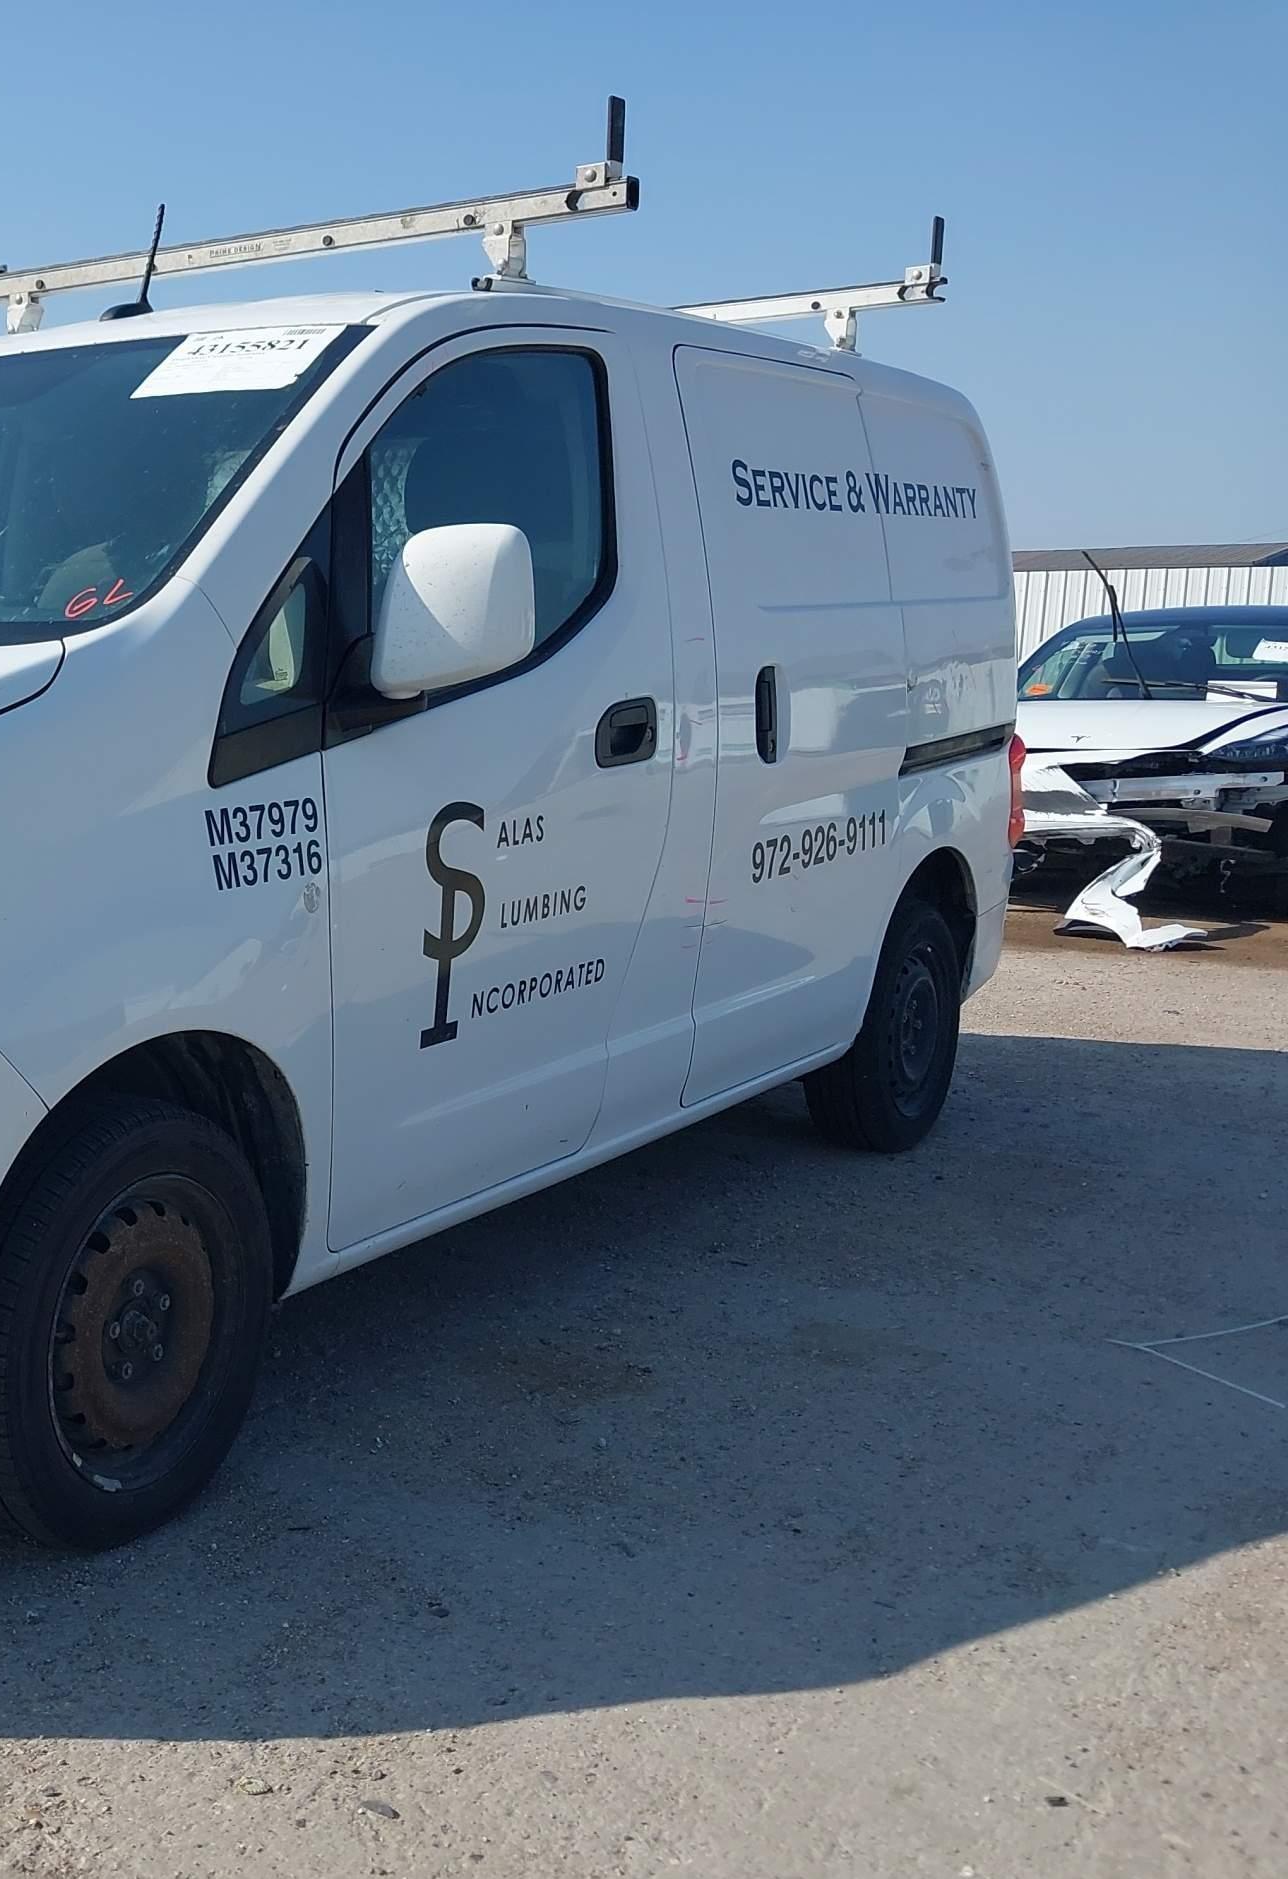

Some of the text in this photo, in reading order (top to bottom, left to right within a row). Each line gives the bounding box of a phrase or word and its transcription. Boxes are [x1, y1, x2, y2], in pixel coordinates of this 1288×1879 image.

[233, 241, 262, 255] DESIGN
[187, 339, 311, 356] 43155821
[845, 470, 865, 513] &
[204, 797, 318, 847] M37979
[212, 839, 322, 891] M37316
[751, 809, 886, 883] 972-926-9111
